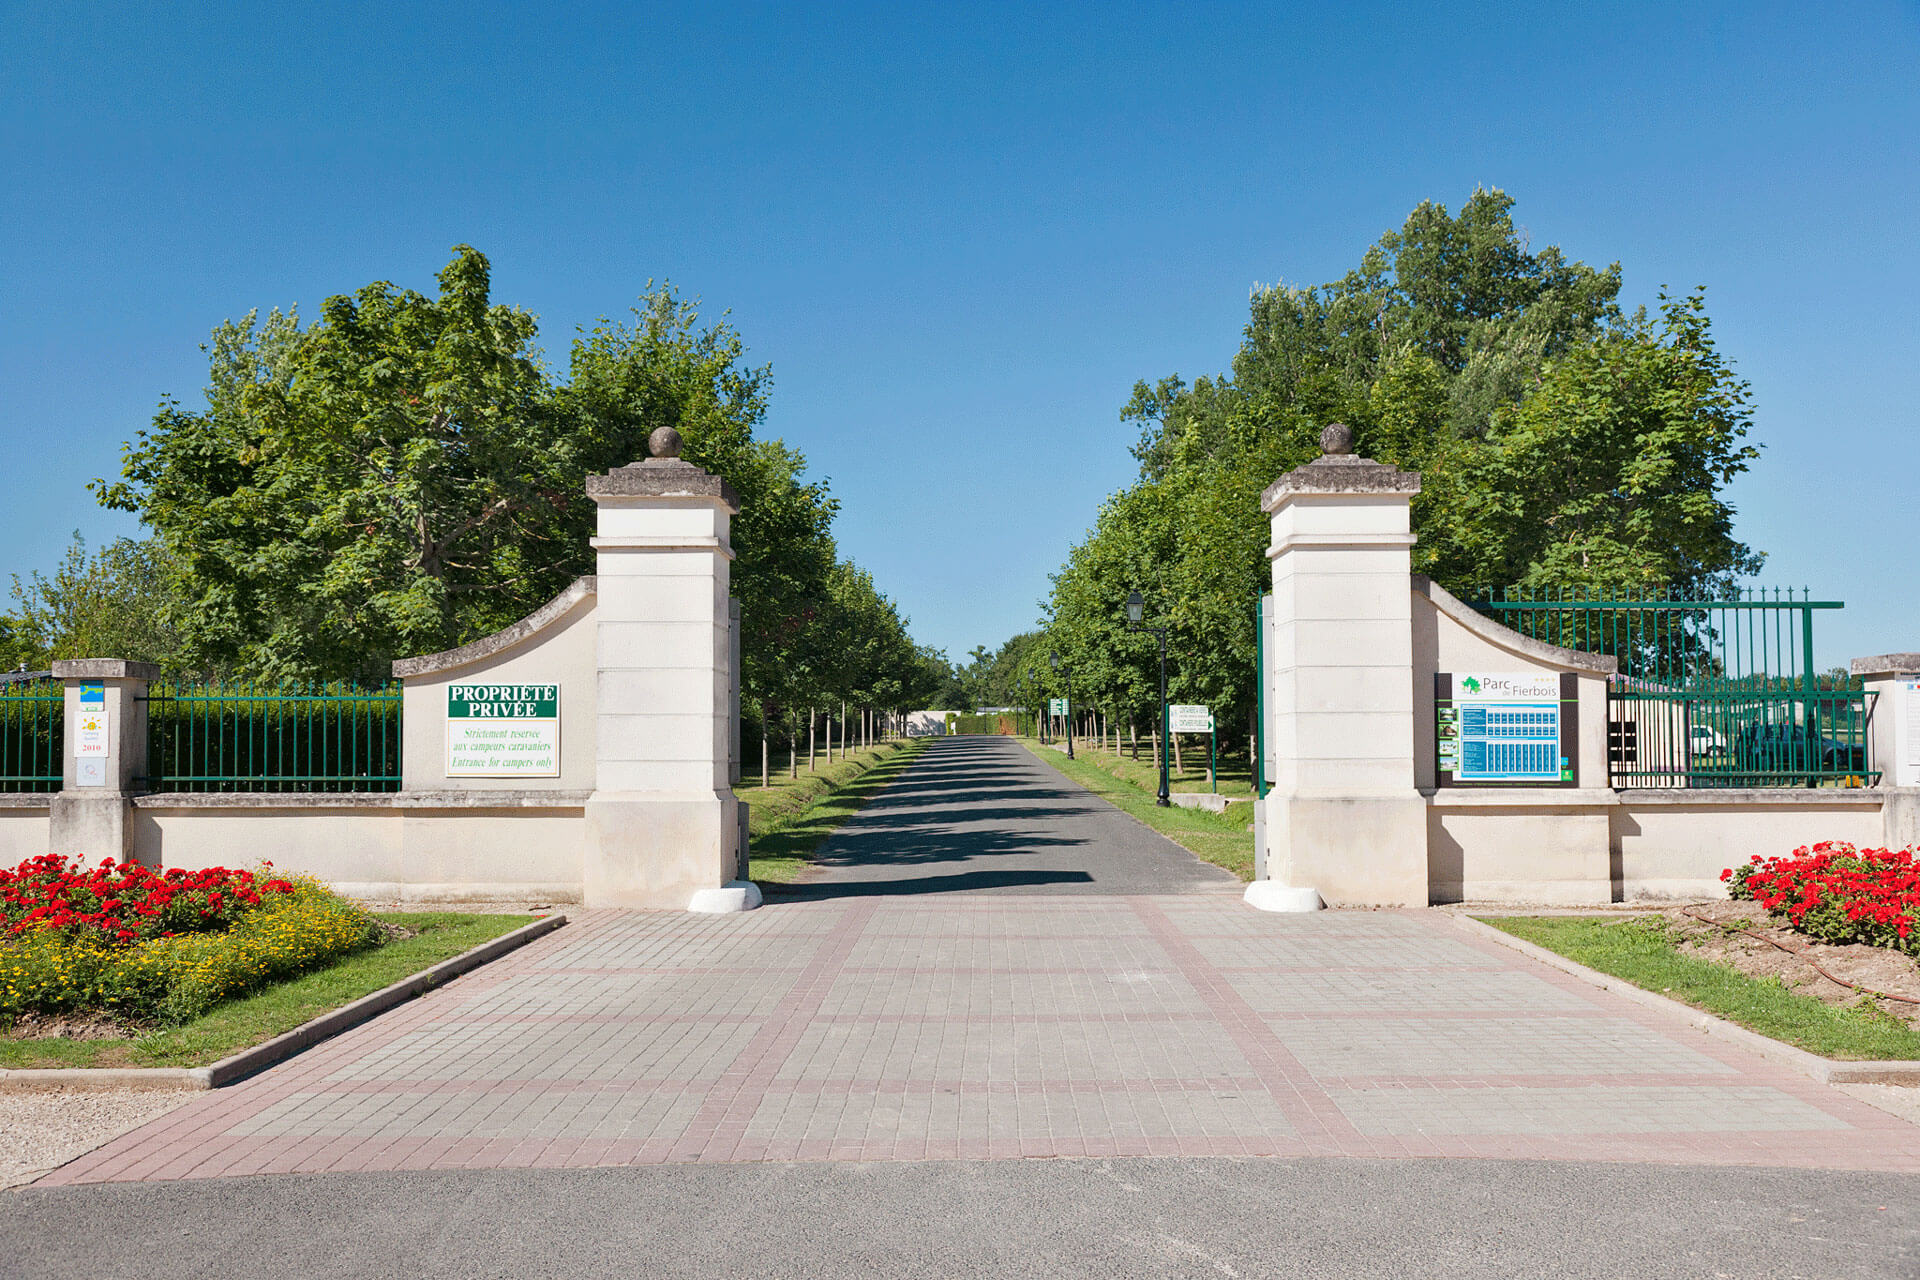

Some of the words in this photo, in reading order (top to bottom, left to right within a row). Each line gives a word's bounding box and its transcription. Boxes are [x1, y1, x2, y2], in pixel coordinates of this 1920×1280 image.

[1483, 677, 1511, 690] Parc
[1512, 685, 1557, 697] Fierbois
[468, 701, 537, 717] PRIVÉE
[464, 727, 509, 739] Strictement
[82, 744, 101, 752] 2010
[453, 743, 468, 751] aux
[470, 743, 506, 753] campeurs
[508, 741, 551, 751] caravaniers
[452, 756, 486, 767] Entrance
[488, 756, 501, 767] for
[502, 759, 534, 769] campers
[535, 756, 552, 768] only
